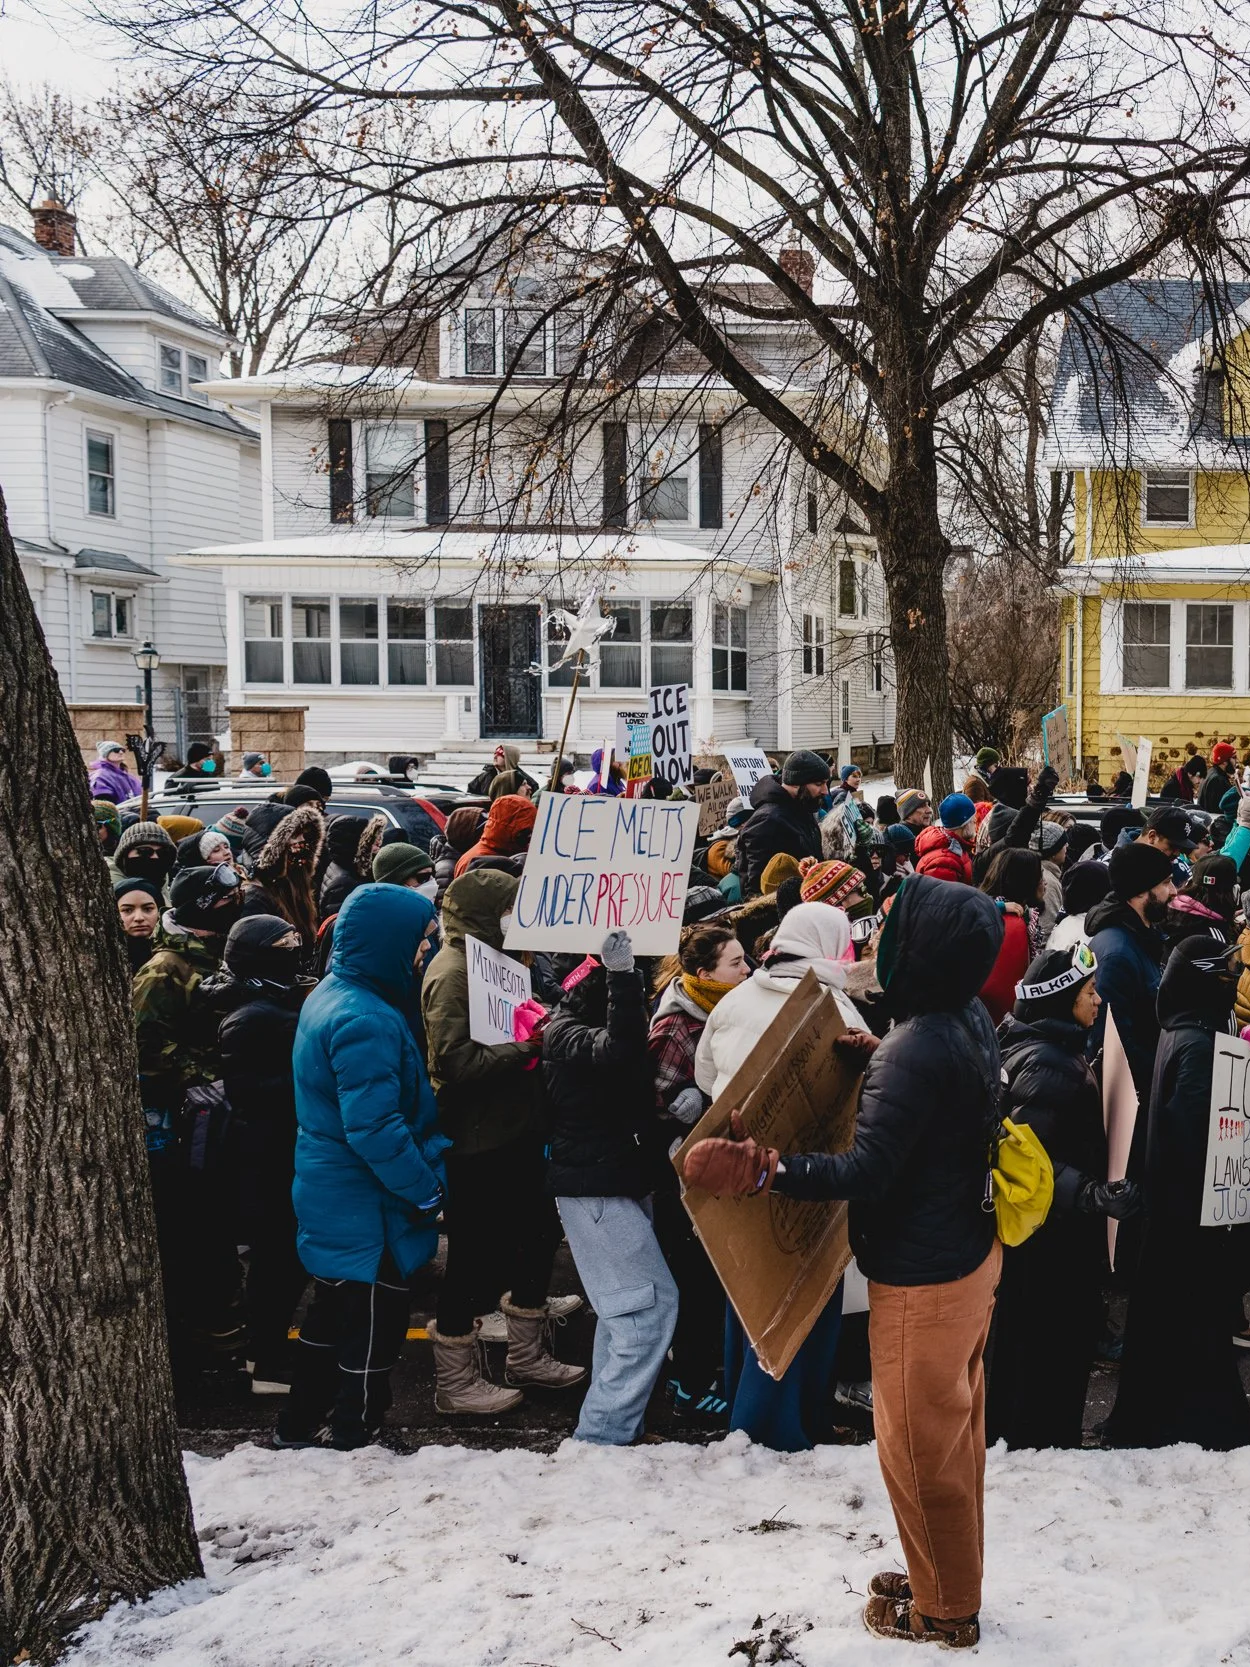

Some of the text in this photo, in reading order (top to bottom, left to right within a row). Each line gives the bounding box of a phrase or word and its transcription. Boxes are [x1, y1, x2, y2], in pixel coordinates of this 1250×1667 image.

[650, 686, 687, 719] ICE
[652, 720, 689, 758] OUT
[654, 754, 692, 786] NOW
[731, 758, 766, 768] HISTORY
[750, 771, 758, 782] IS
[698, 784, 732, 802] WE WALK
[540, 796, 686, 862] ICE MELTS
[518, 872, 684, 929] UNDER PRESSURE
[472, 943, 527, 1000] MINNESOTA
[1029, 972, 1075, 997] ALKAI
